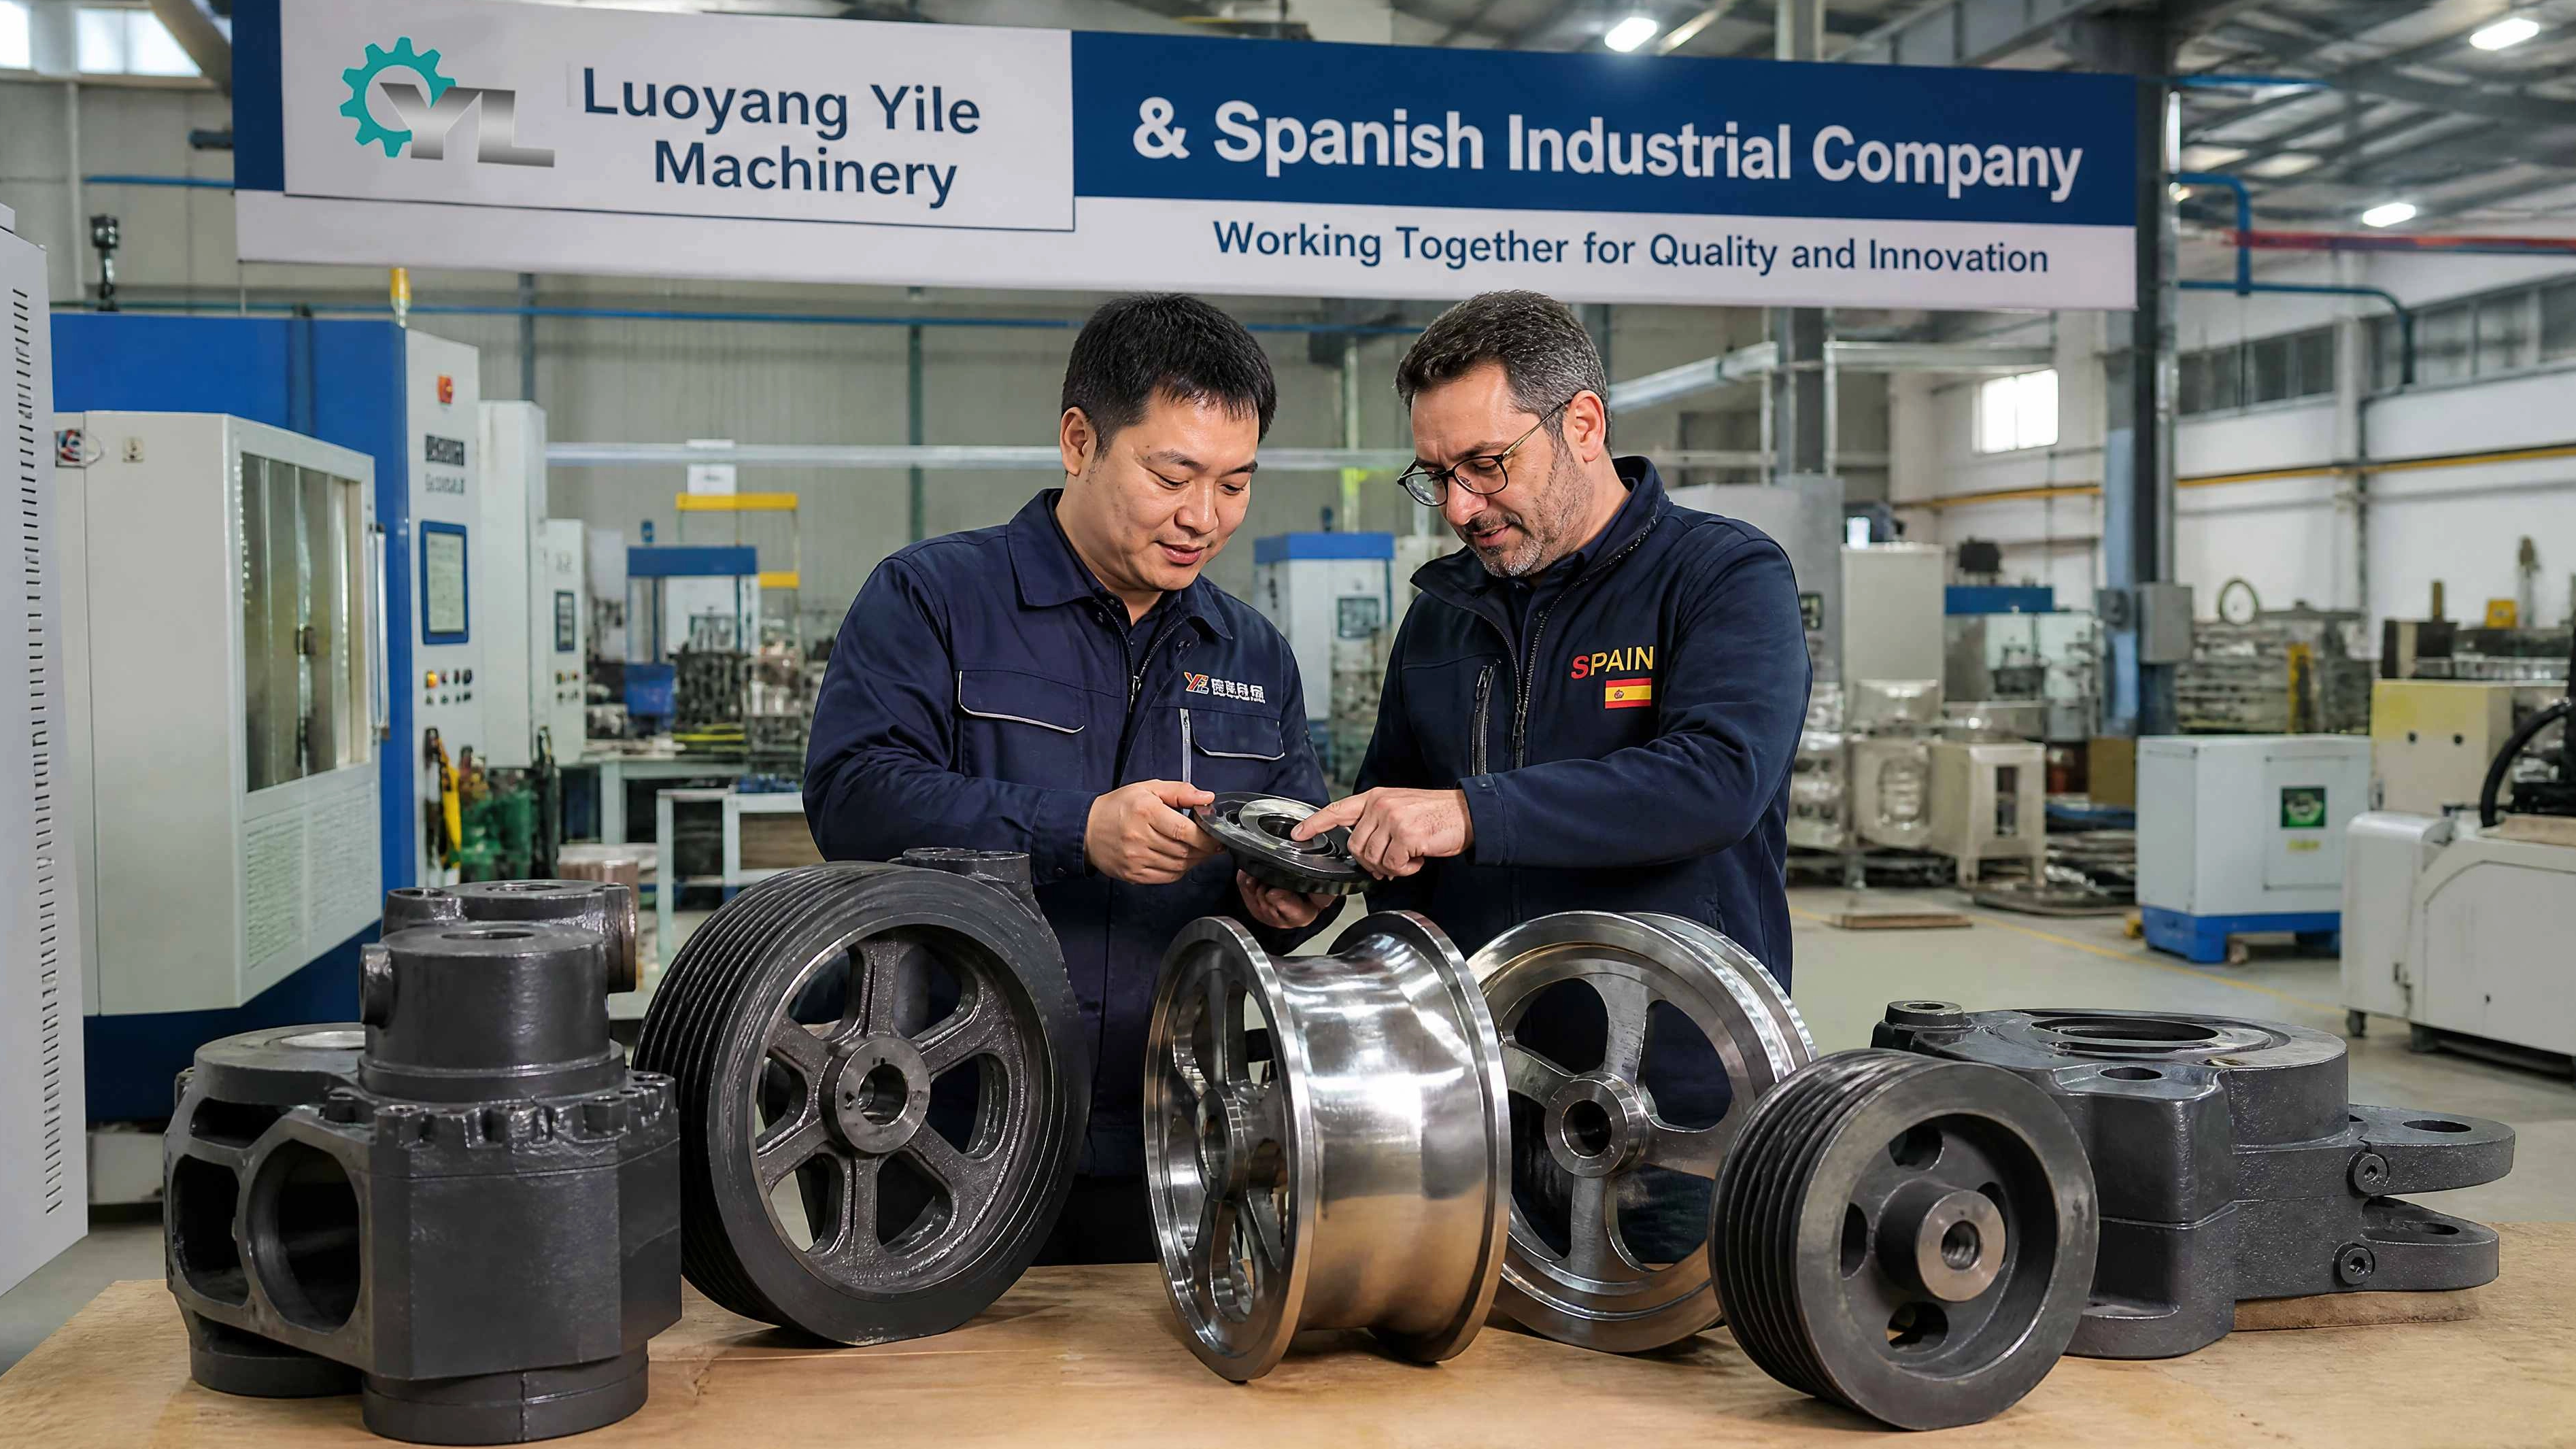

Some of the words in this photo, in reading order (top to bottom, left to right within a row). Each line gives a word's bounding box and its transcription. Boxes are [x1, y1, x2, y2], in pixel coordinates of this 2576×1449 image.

[379, 82, 555, 168] YL
[583, 67, 848, 141] Luoyang
[870, 84, 981, 135] Yile
[655, 140, 957, 209] Machinery
[1133, 97, 1190, 159] &
[1213, 100, 1484, 177] Spanish
[1509, 114, 1791, 179] Industrial
[1812, 125, 2082, 202] Company
[1213, 220, 1380, 267] Working
[1395, 226, 1569, 270] Together
[1583, 232, 1636, 265] for
[1650, 233, 1778, 277] Quality
[1791, 238, 1856, 270] and
[1870, 238, 2048, 273] Innovation
[1571, 646, 1655, 679] SPAIN
